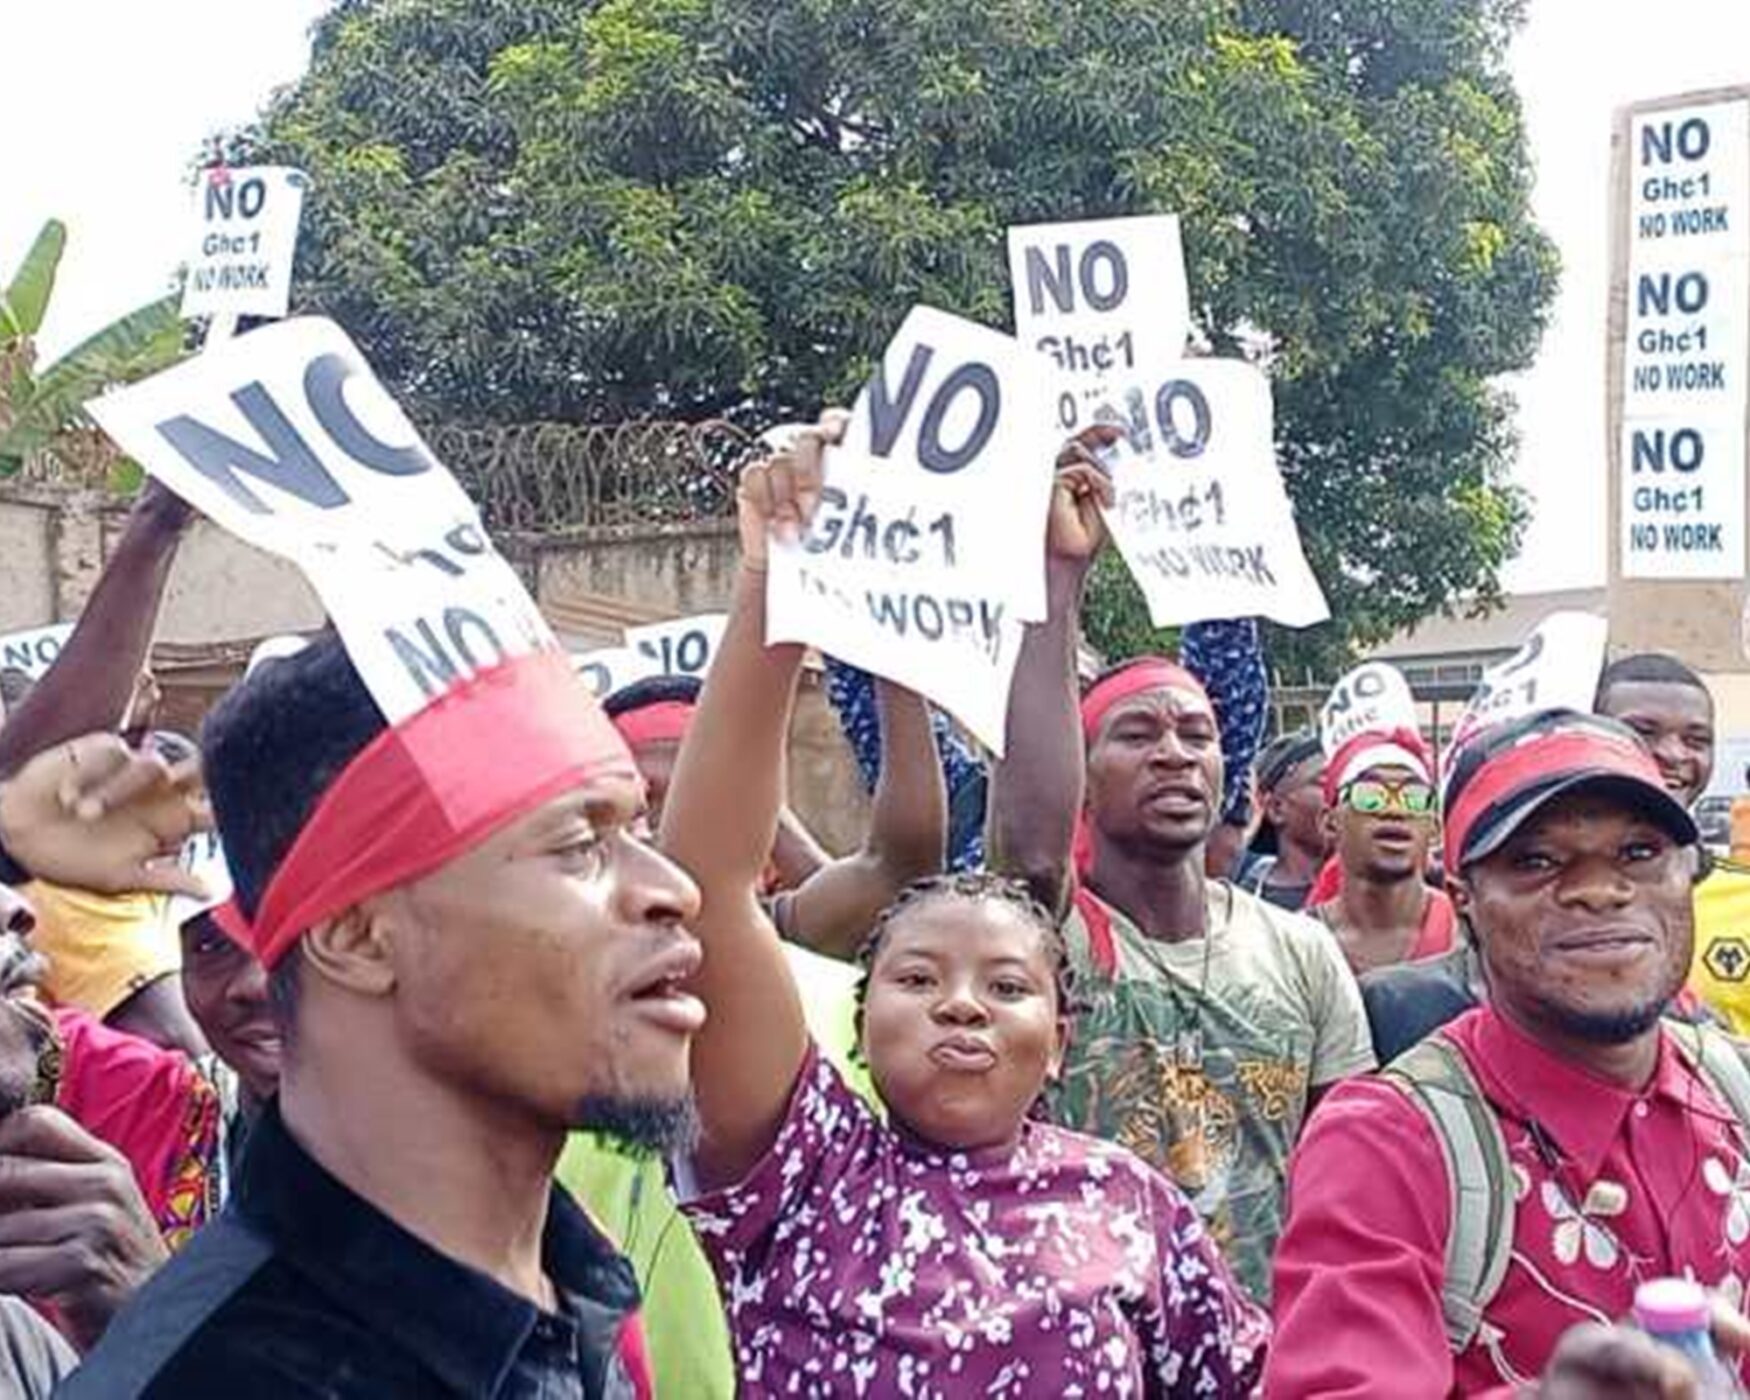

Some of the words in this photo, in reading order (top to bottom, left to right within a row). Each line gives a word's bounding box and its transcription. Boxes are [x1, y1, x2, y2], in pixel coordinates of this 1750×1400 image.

[1641, 117, 1710, 165] NO
[205, 178, 266, 221] NO
[1639, 213, 1666, 238] NO
[1672, 206, 1728, 236] WORK
[1025, 240, 1128, 313] NO
[1638, 272, 1708, 317] NO
[1633, 365, 1661, 392] NO
[1666, 362, 1725, 391] WORK
[870, 344, 1000, 474] NO
[1632, 428, 1704, 473] NO
[1630, 523, 1658, 552] NO
[1663, 523, 1724, 552] WORK
[4, 634, 60, 668] NO
[384, 607, 507, 697] NO
